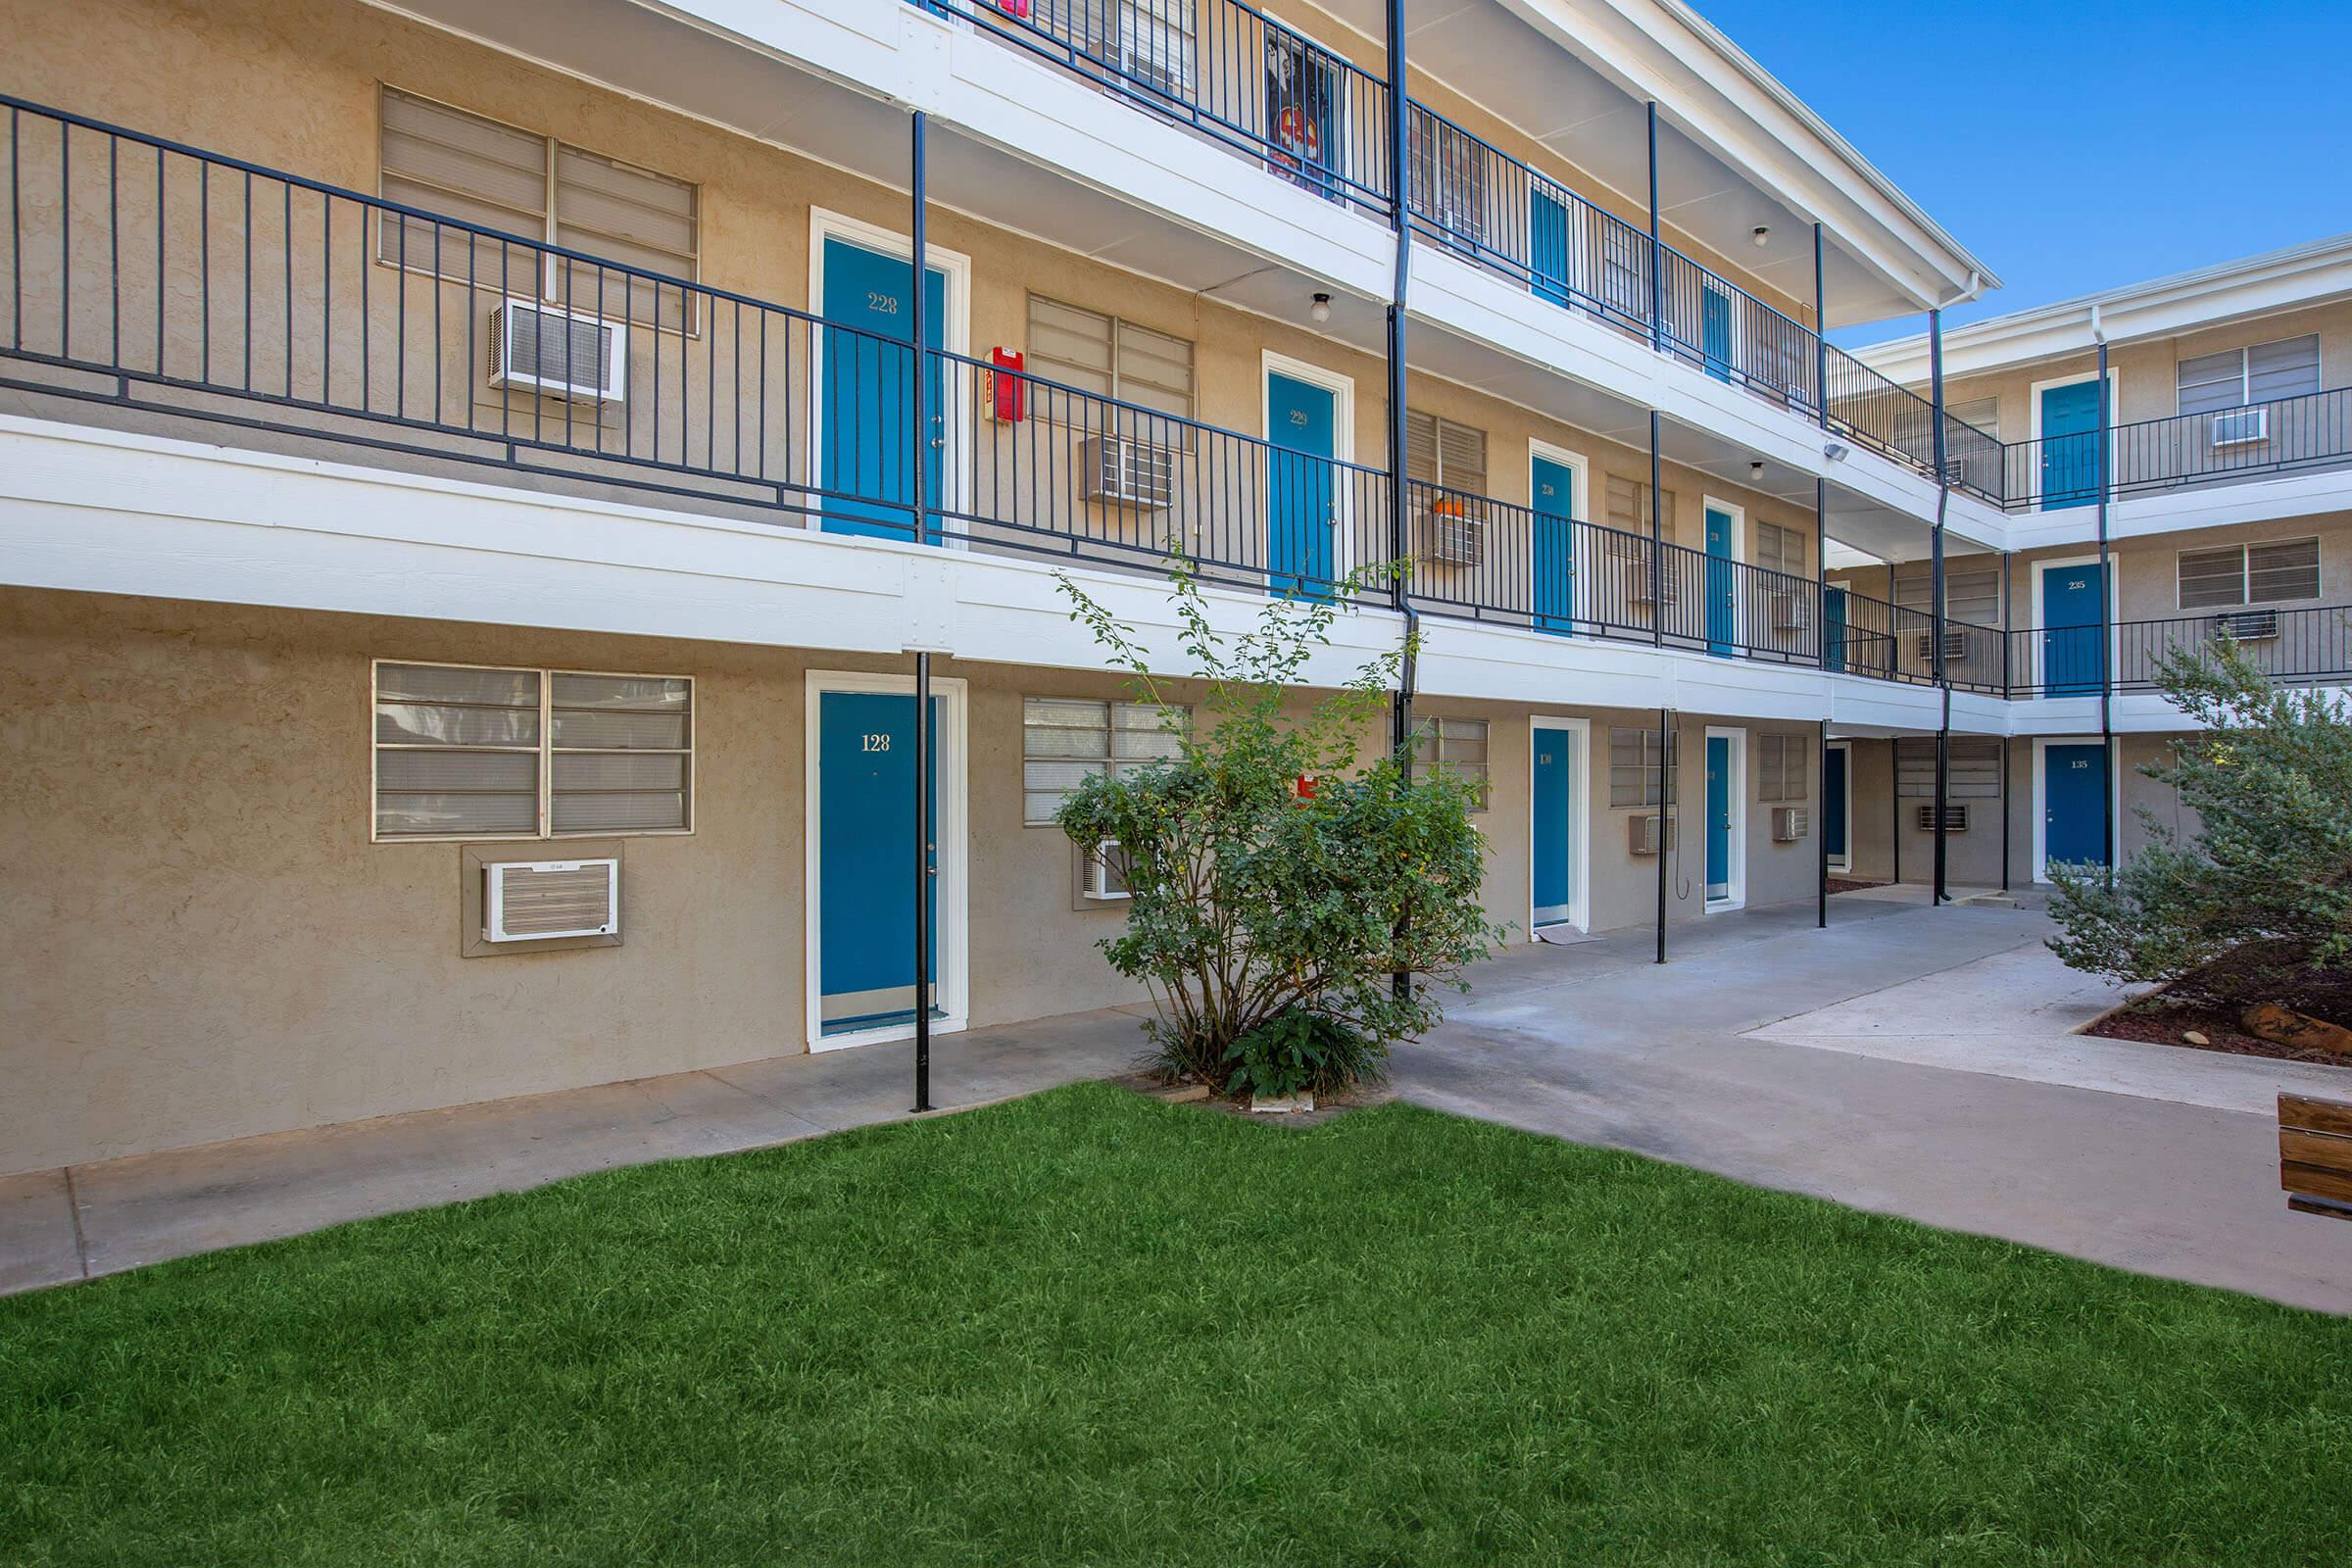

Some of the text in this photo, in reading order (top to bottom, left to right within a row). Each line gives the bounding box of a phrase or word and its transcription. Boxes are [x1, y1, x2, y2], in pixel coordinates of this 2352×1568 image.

[868, 292, 898, 314] 228
[2069, 580, 2085, 590] 235
[861, 733, 891, 752] 128
[2071, 760, 2087, 769] 135
